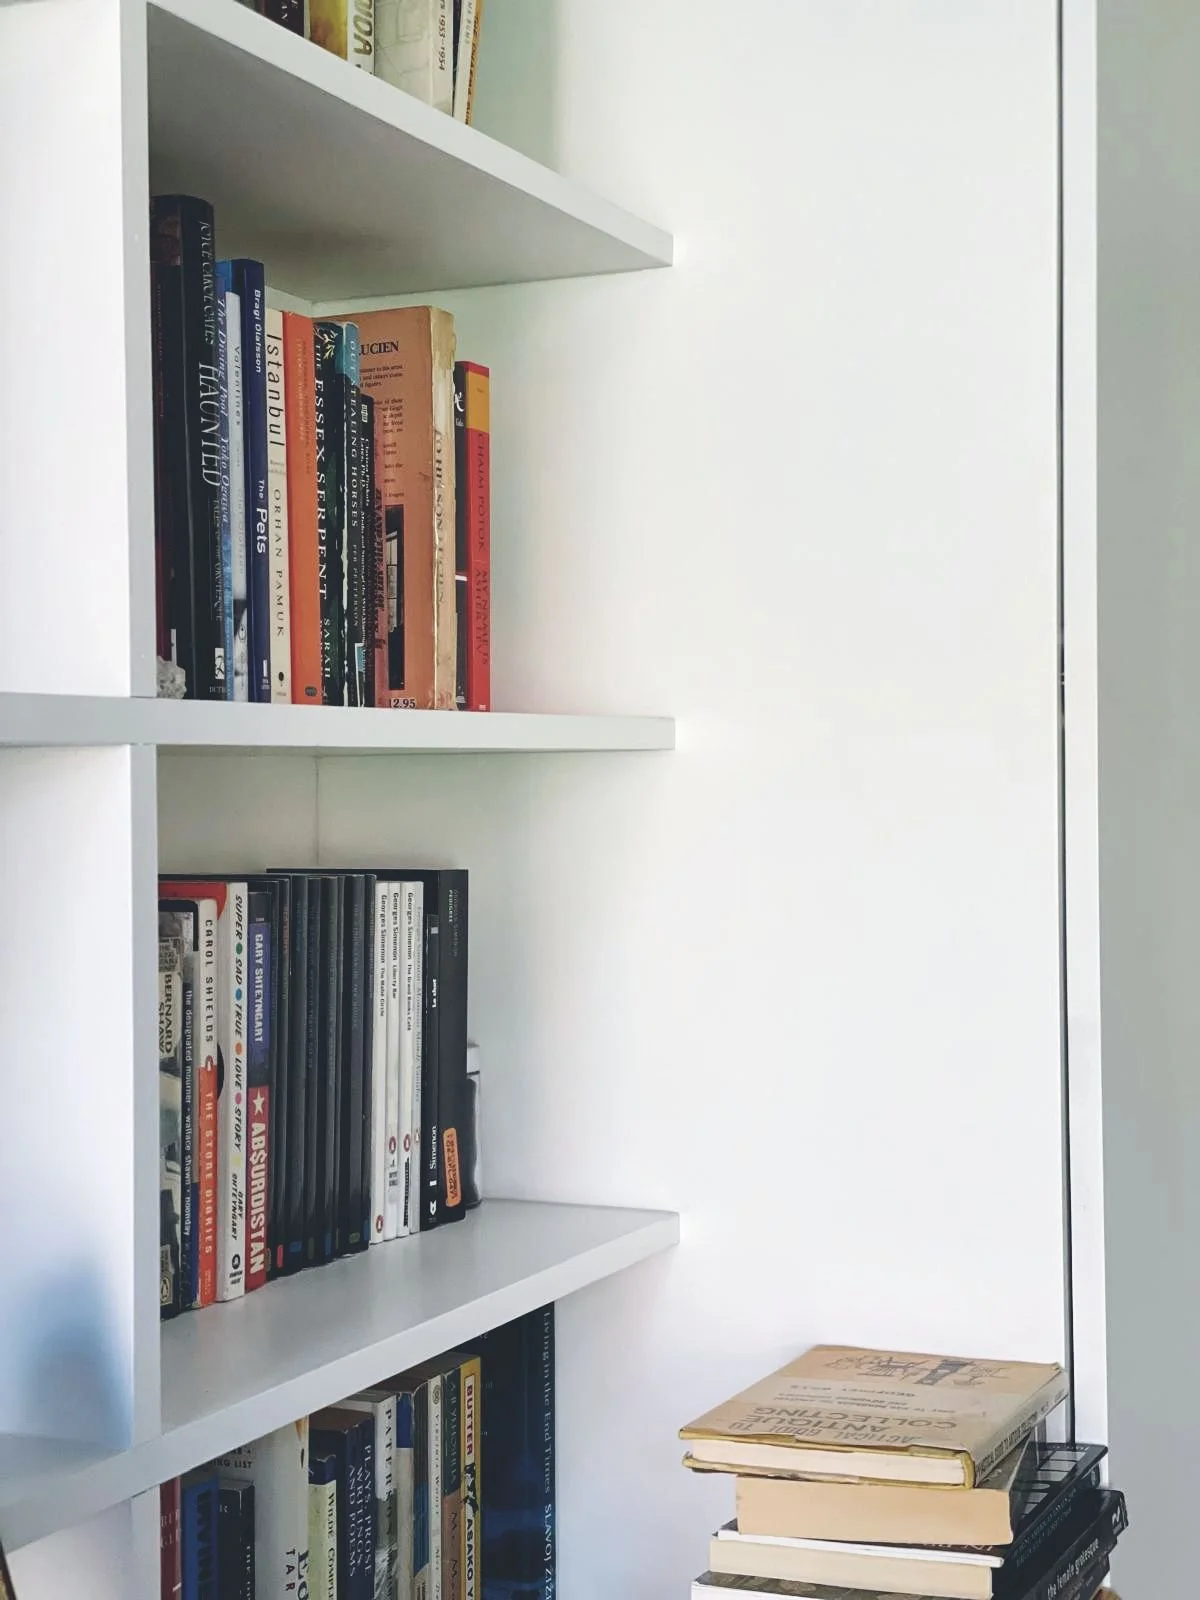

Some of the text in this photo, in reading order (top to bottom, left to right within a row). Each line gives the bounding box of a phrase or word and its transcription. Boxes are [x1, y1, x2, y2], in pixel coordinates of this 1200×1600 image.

[253, 289, 263, 320] Bragi
[350, 339, 358, 376] OUT
[359, 341, 399, 356] UCIEN
[216, 297, 231, 523] The Diving Pool Yoko Ogawa
[266, 332, 286, 447] Istanbul
[199, 362, 222, 487] HAUNTED
[315, 379, 325, 463] ESSEX
[255, 480, 269, 554] The Pets
[351, 466, 360, 528] HORSES
[477, 433, 486, 553] CHAIM POTOK
[273, 489, 286, 638] ORHAN PAMUK
[317, 471, 327, 601] SERPENT
[481, 569, 488, 595] MY
[323, 618, 332, 679] SARAH
[380, 894, 388, 928] Georges
[392, 892, 400, 926] Georges
[406, 892, 414, 926] Georges
[380, 929, 388, 964] Simenon
[392, 927, 400, 962] Simenon
[165, 974, 173, 1055] BERNARD
[185, 990, 193, 1006] the
[254, 933, 265, 1043] GARY SHTEYNGART
[183, 1009, 193, 1061] designated
[234, 894, 244, 1152] SUPER SAD TRUE LOVE STORY
[205, 919, 215, 1255] CAROL SHIELDS THE STONE DIARIES
[185, 1115, 193, 1151] wallace
[429, 1125, 438, 1170] Simenon
[184, 1155, 193, 1186] shawn
[183, 1196, 192, 1237] noonday
[465, 1385, 474, 1456] BUTTER
[542, 1312, 553, 1562] Living in the End Times SLAVOJ
[740, 1414, 890, 1433] ANTIQUE
[753, 1407, 958, 1430] COLLECTING
[833, 1429, 923, 1443] ACTICAL
[234, 1459, 253, 1469] LIST
[384, 1408, 393, 1537] PATERSON
[327, 1492, 336, 1600] WILDE COMPLE
[348, 1464, 356, 1577] AND POEMS
[356, 1464, 364, 1567] WRITINGS
[364, 1514, 373, 1577] PROSE
[285, 1548, 297, 1592] TAR
[465, 1518, 475, 1581] ASAKO
[1056, 1562, 1075, 1591] female
[1074, 1538, 1099, 1576] grotesque
